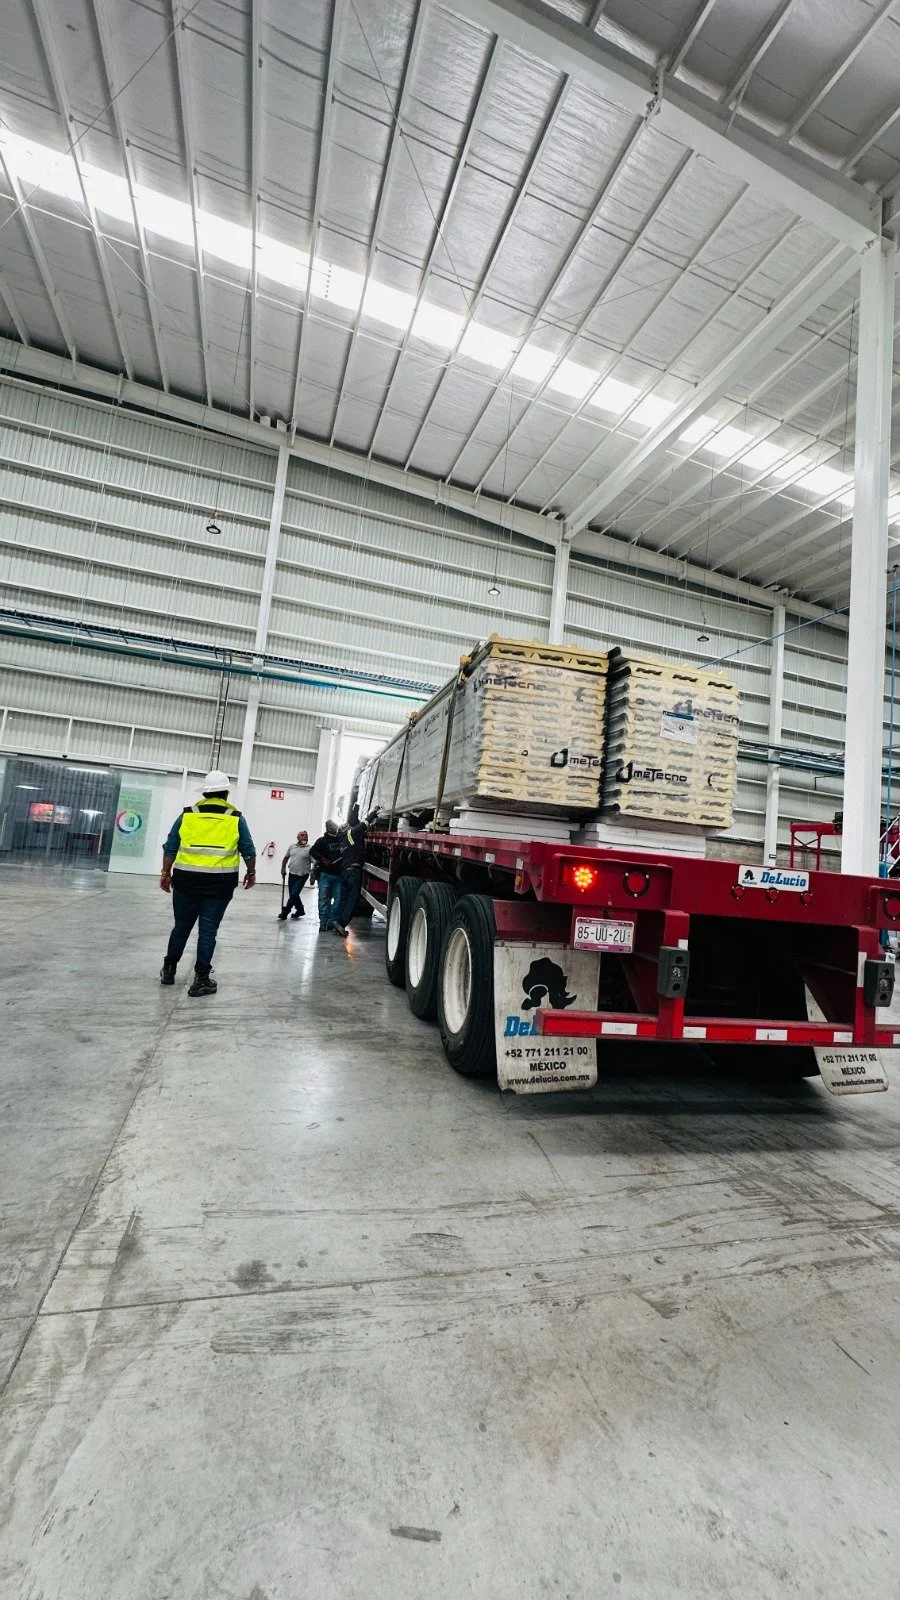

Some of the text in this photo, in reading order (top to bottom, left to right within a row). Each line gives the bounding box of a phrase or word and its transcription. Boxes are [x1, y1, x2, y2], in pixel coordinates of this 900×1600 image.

[570, 755, 600, 768] meTe
[760, 871, 806, 886] DeLucio
[505, 1046, 588, 1058] +52 771 211 21 00
[822, 1053, 877, 1063] +52 771 211 21 00
[529, 1061, 567, 1072] MÉXICO
[507, 1074, 590, 1086] www.delucio.com.mx
